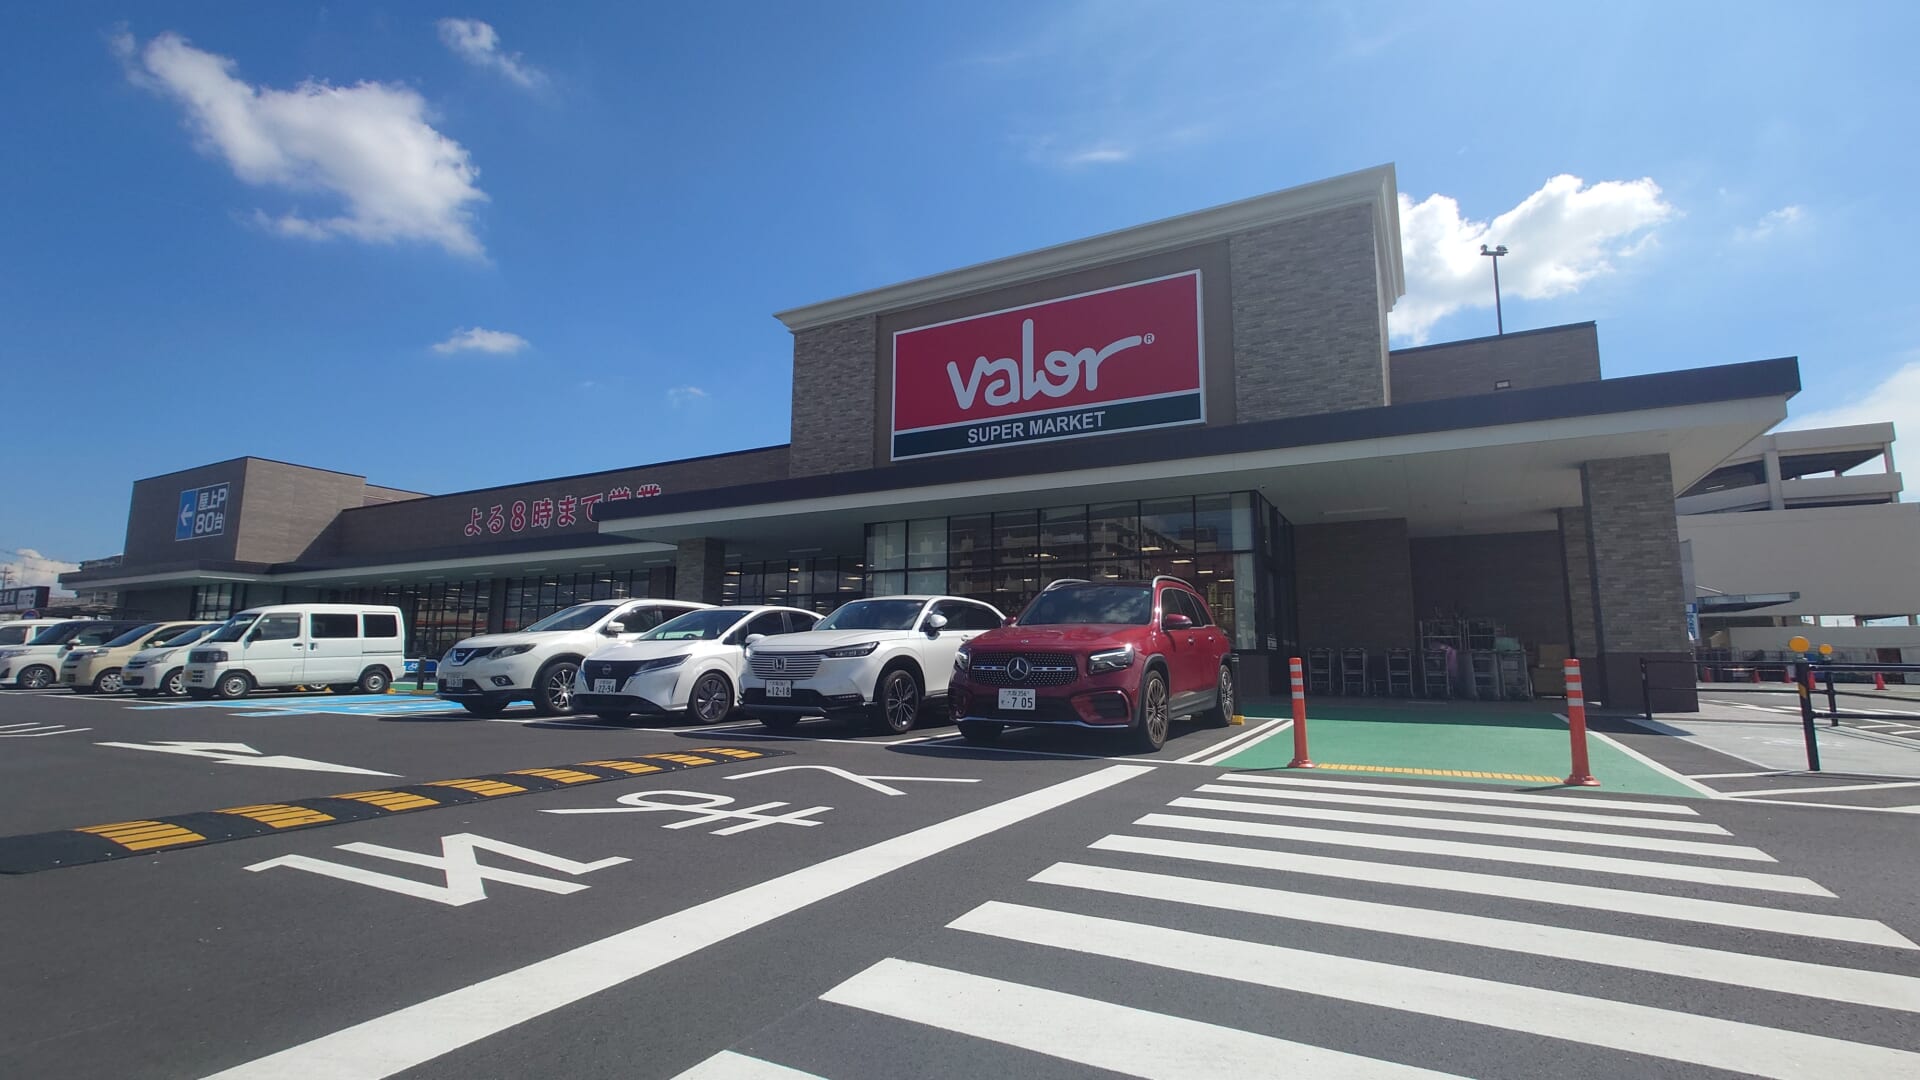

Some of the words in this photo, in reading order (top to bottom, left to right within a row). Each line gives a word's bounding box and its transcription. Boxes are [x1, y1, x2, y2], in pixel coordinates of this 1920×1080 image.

[946, 318, 1142, 410] valor
[967, 421, 1025, 444] SUPER
[1029, 410, 1106, 436] MARKET
[194, 511, 225, 534] 80台
